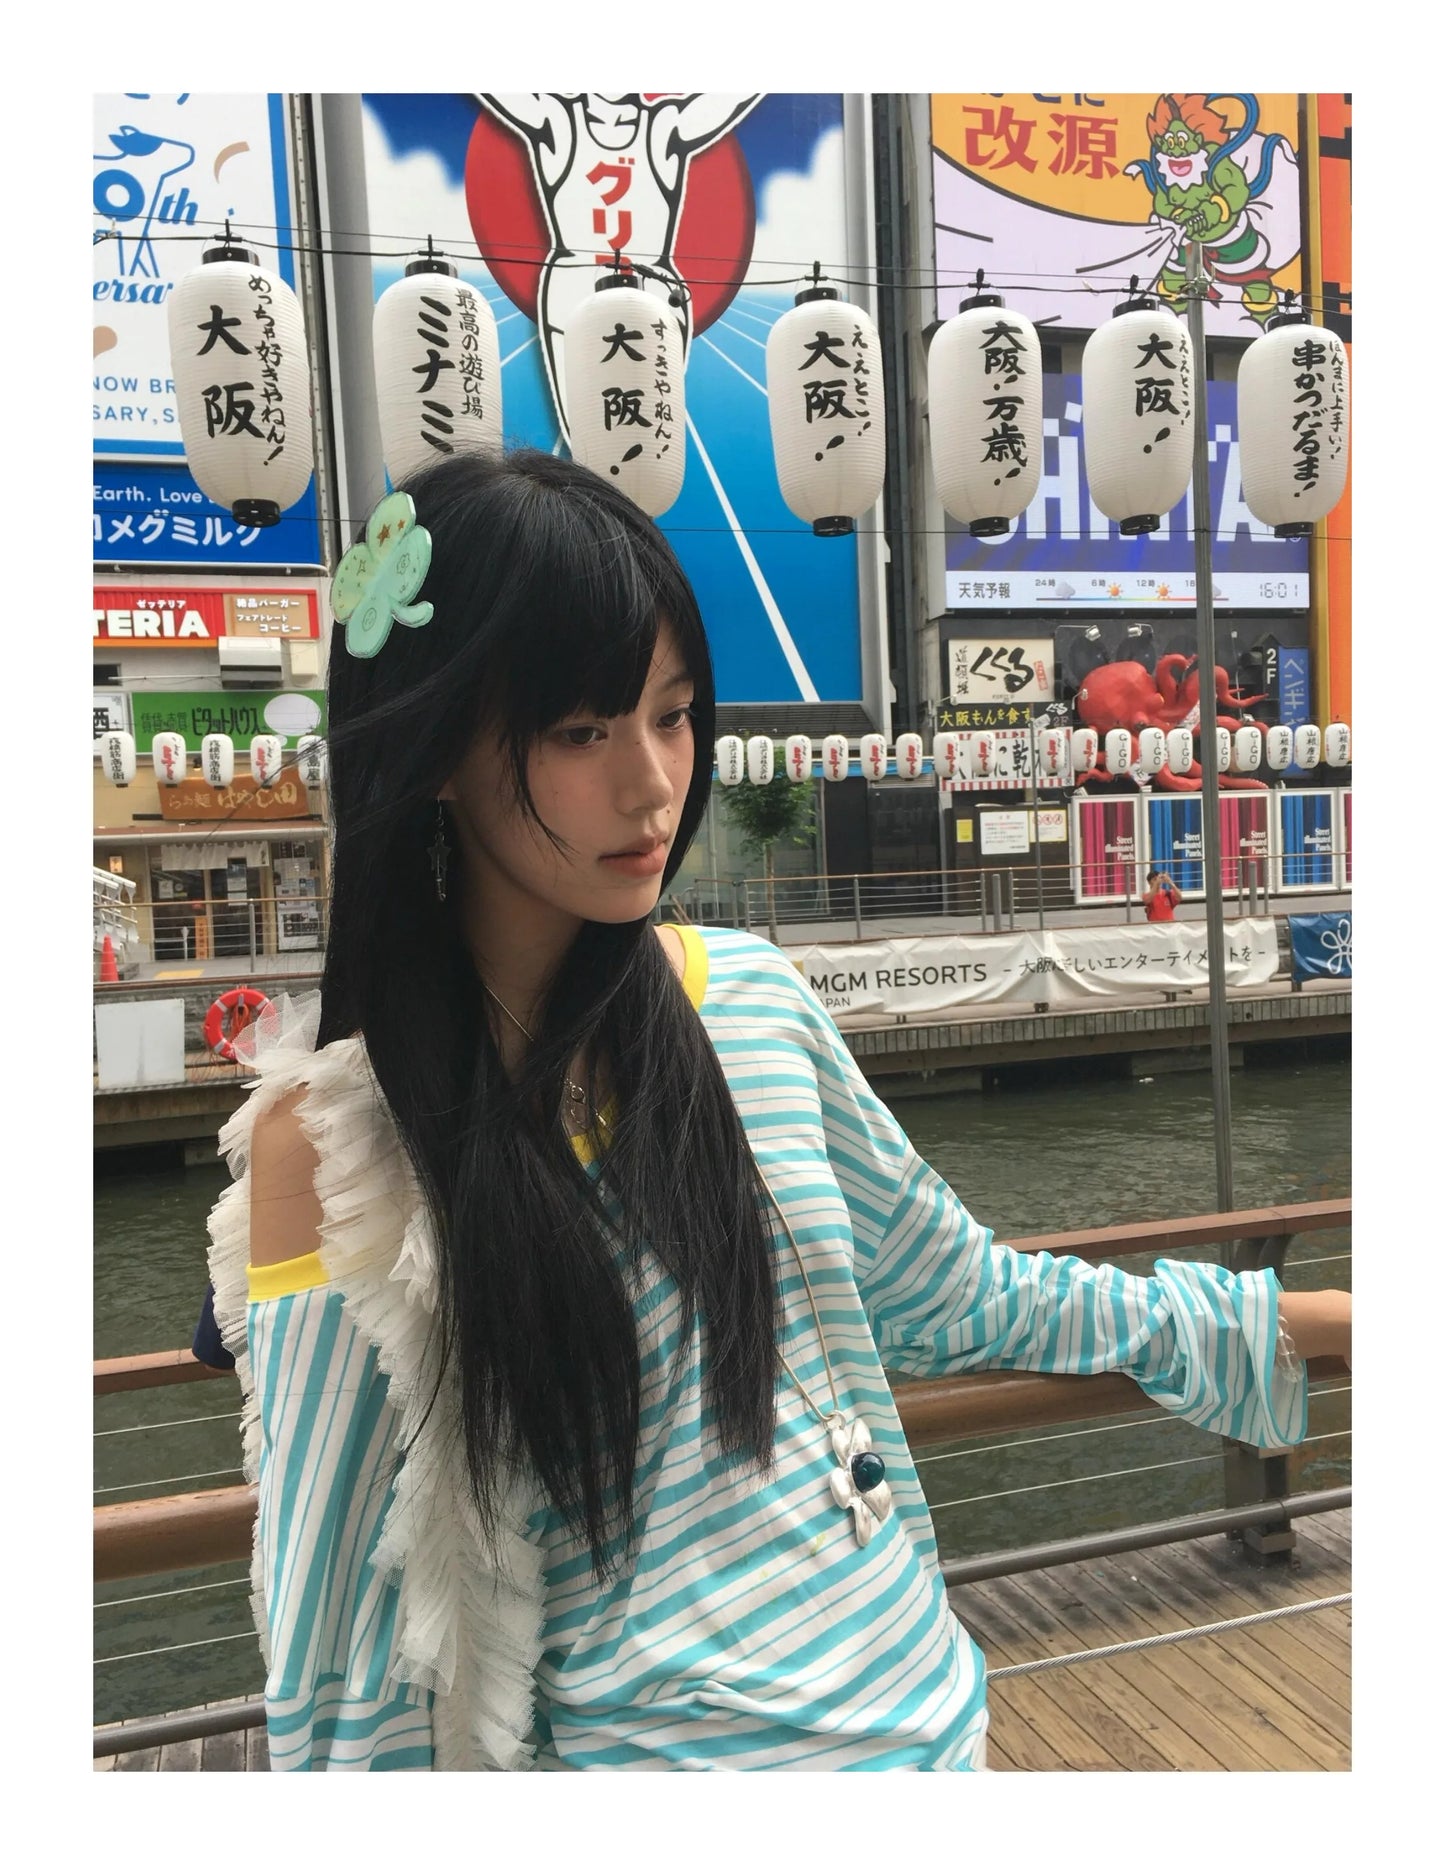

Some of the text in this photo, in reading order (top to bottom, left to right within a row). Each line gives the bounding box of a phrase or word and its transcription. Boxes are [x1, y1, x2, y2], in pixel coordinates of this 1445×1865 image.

[963, 105, 1120, 179] 改源
[197, 304, 265, 439] 大阪
[248, 273, 287, 466] めっちゃ好きやねん！
[412, 296, 456, 453] ミナミ
[455, 288, 484, 419] 最高の遊び場
[600, 322, 653, 475] 大阪！
[650, 319, 674, 459] すっきやねん！
[797, 331, 857, 461] 大阪！
[852, 324, 871, 437] ええとこ！
[978, 320, 1029, 486] 大阪！万歳！
[1133, 332, 1180, 454] 大阪！
[1328, 340, 1345, 459] ほんまに上手い！
[1291, 339, 1328, 498] 串かつだるま！
[160, 488, 202, 503] Love
[137, 599, 187, 609] ゼッテリア
[259, 624, 302, 632] コーヒー
[958, 582, 1011, 599] 天気予報
[1260, 582, 1298, 598] 16:01
[969, 646, 1034, 693] くくる
[1266, 648, 1277, 684] 2F
[810, 971, 867, 993] MGM
[876, 963, 987, 989] RESORTS
